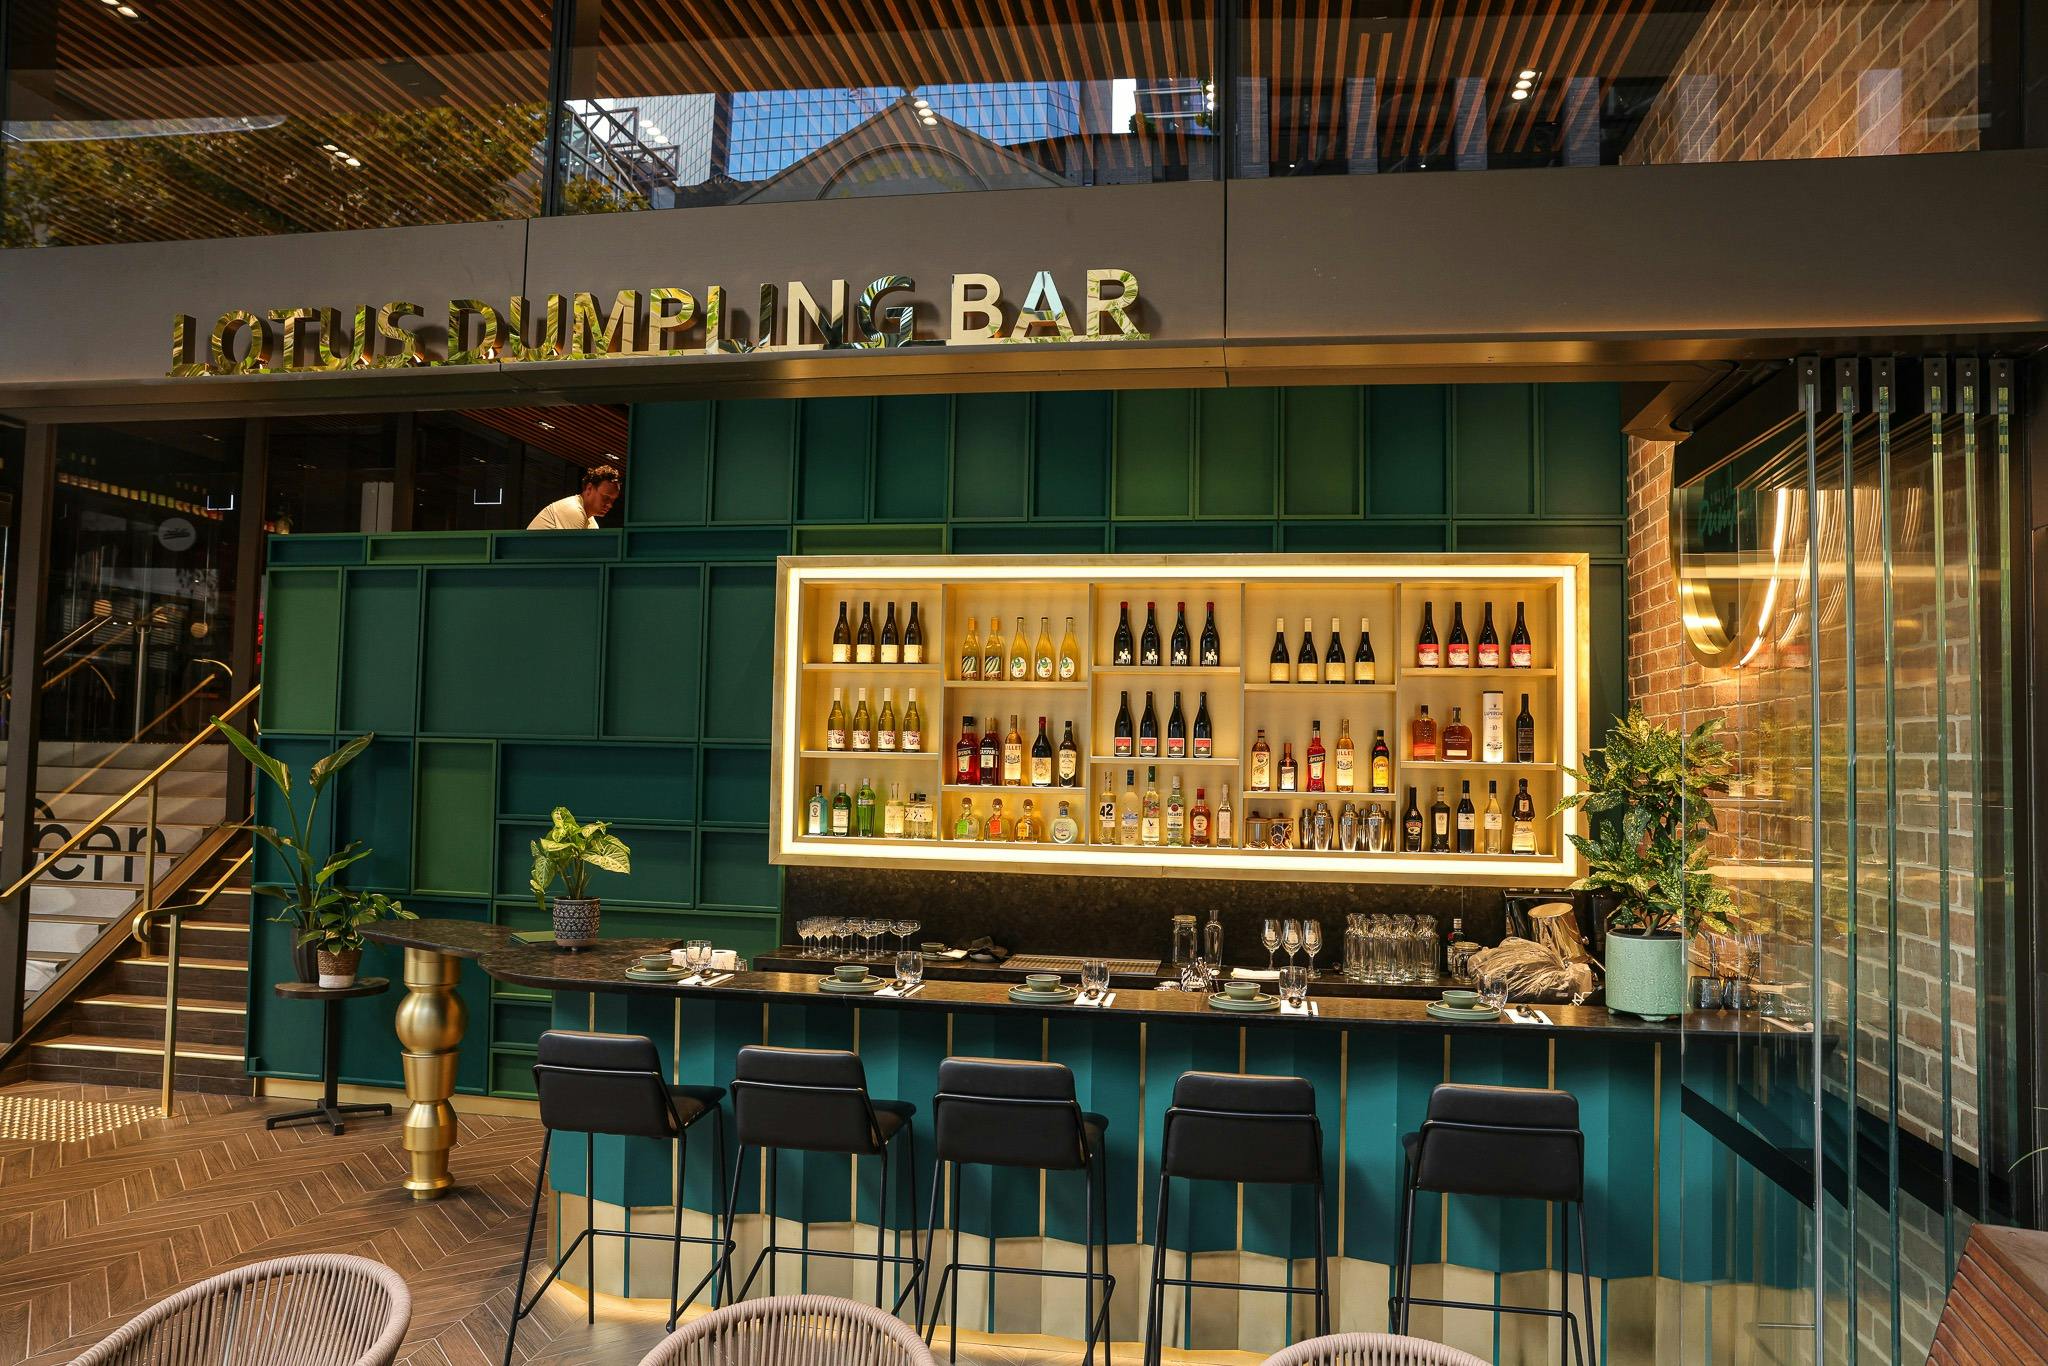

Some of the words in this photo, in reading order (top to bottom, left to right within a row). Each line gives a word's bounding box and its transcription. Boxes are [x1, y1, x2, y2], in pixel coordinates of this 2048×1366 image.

[167, 301, 424, 377] LOTUS
[449, 275, 915, 365] DUMPLING
[950, 268, 1151, 346] BAR
[1100, 803, 1113, 817] 42
